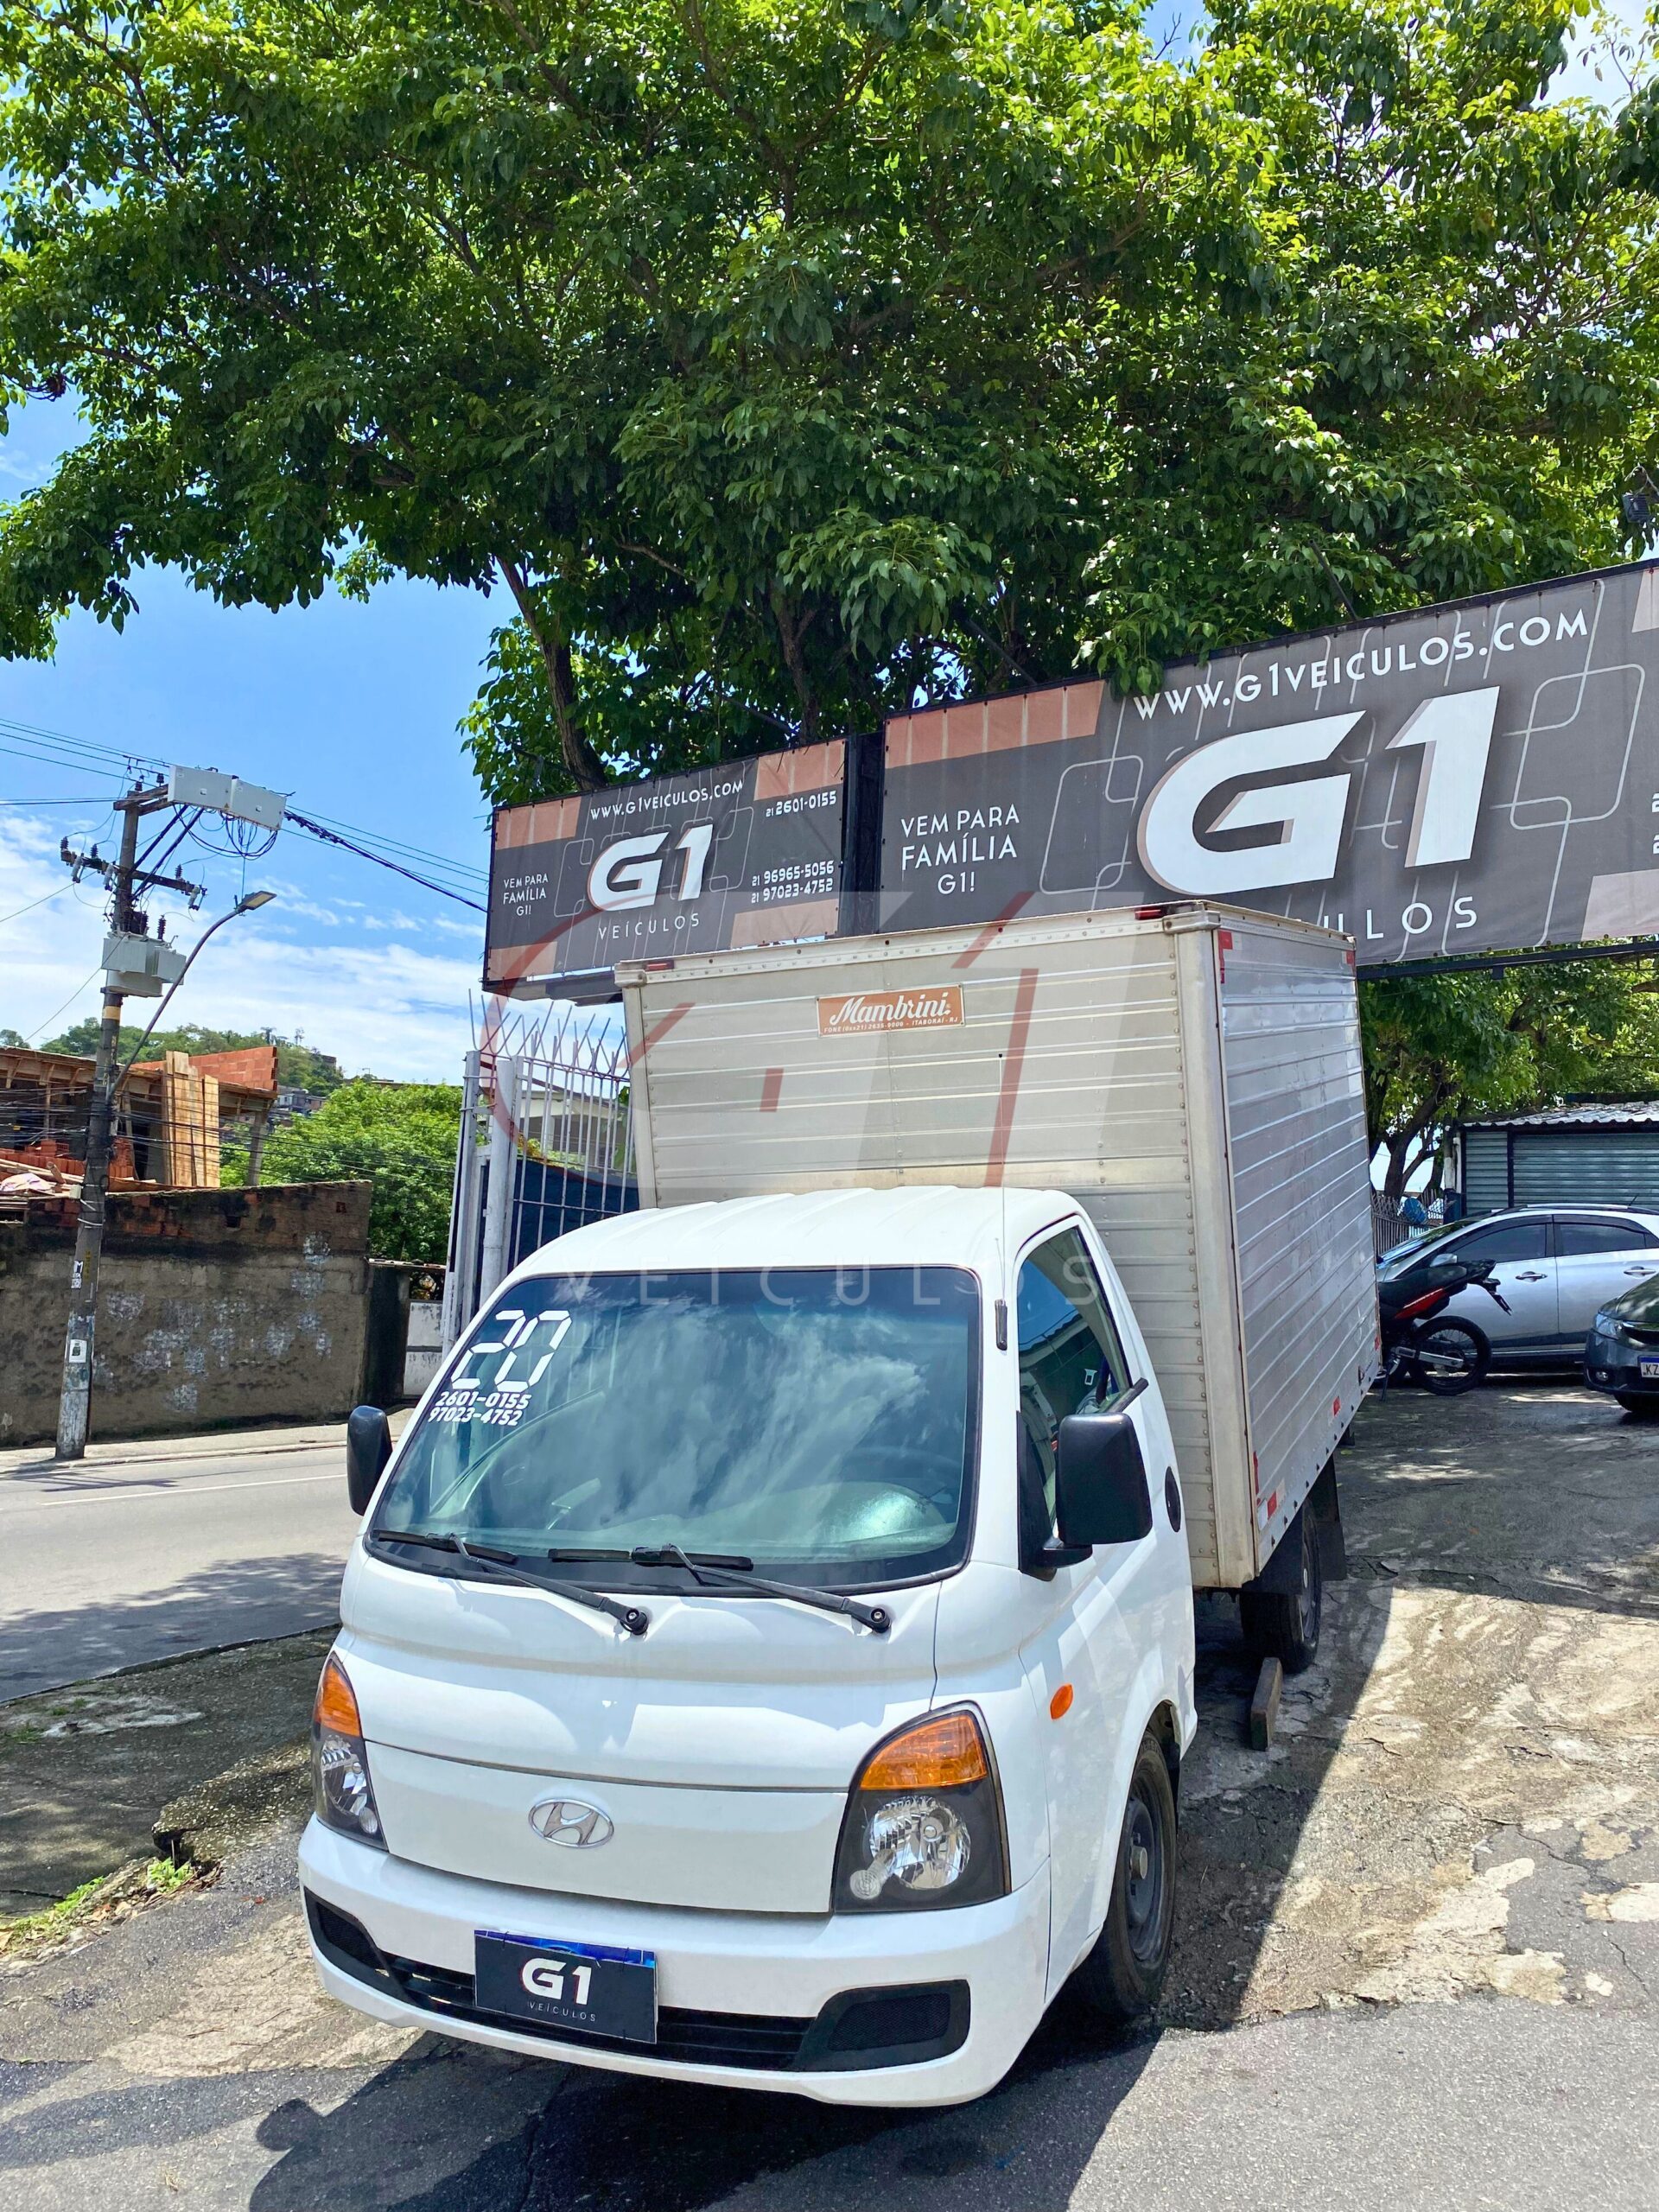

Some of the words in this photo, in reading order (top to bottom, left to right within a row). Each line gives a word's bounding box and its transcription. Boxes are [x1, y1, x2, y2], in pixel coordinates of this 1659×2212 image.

[1133, 608, 1588, 721] WWW.G1VEICULOS.COM
[766, 808, 774, 817] 21
[775, 790, 836, 815] 2601-0155
[1137, 686, 1500, 895] G1
[901, 813, 949, 837] VEM
[957, 804, 1020, 831] PARA
[902, 832, 1017, 870] FAMÍLIA
[504, 877, 522, 888] VEM
[524, 873, 549, 886] PARA
[587, 823, 714, 912] G1
[752, 875, 760, 887] 21
[764, 860, 835, 884] 96965-5056
[503, 887, 546, 905] FAMÍLIA
[751, 893, 760, 904] 21
[763, 878, 833, 901] 97023-4752
[938, 871, 975, 894] G1!
[516, 905, 531, 917] G1!
[599, 912, 700, 940] VEÍCULOS
[830, 992, 950, 1026] Mambrini
[451, 1309, 572, 1393] 20
[435, 1391, 532, 1409] 2601-0155
[428, 1407, 524, 1426] 97023-4752
[521, 1957, 592, 2005] G1
[529, 2000, 596, 2022] VEÍCULOS
